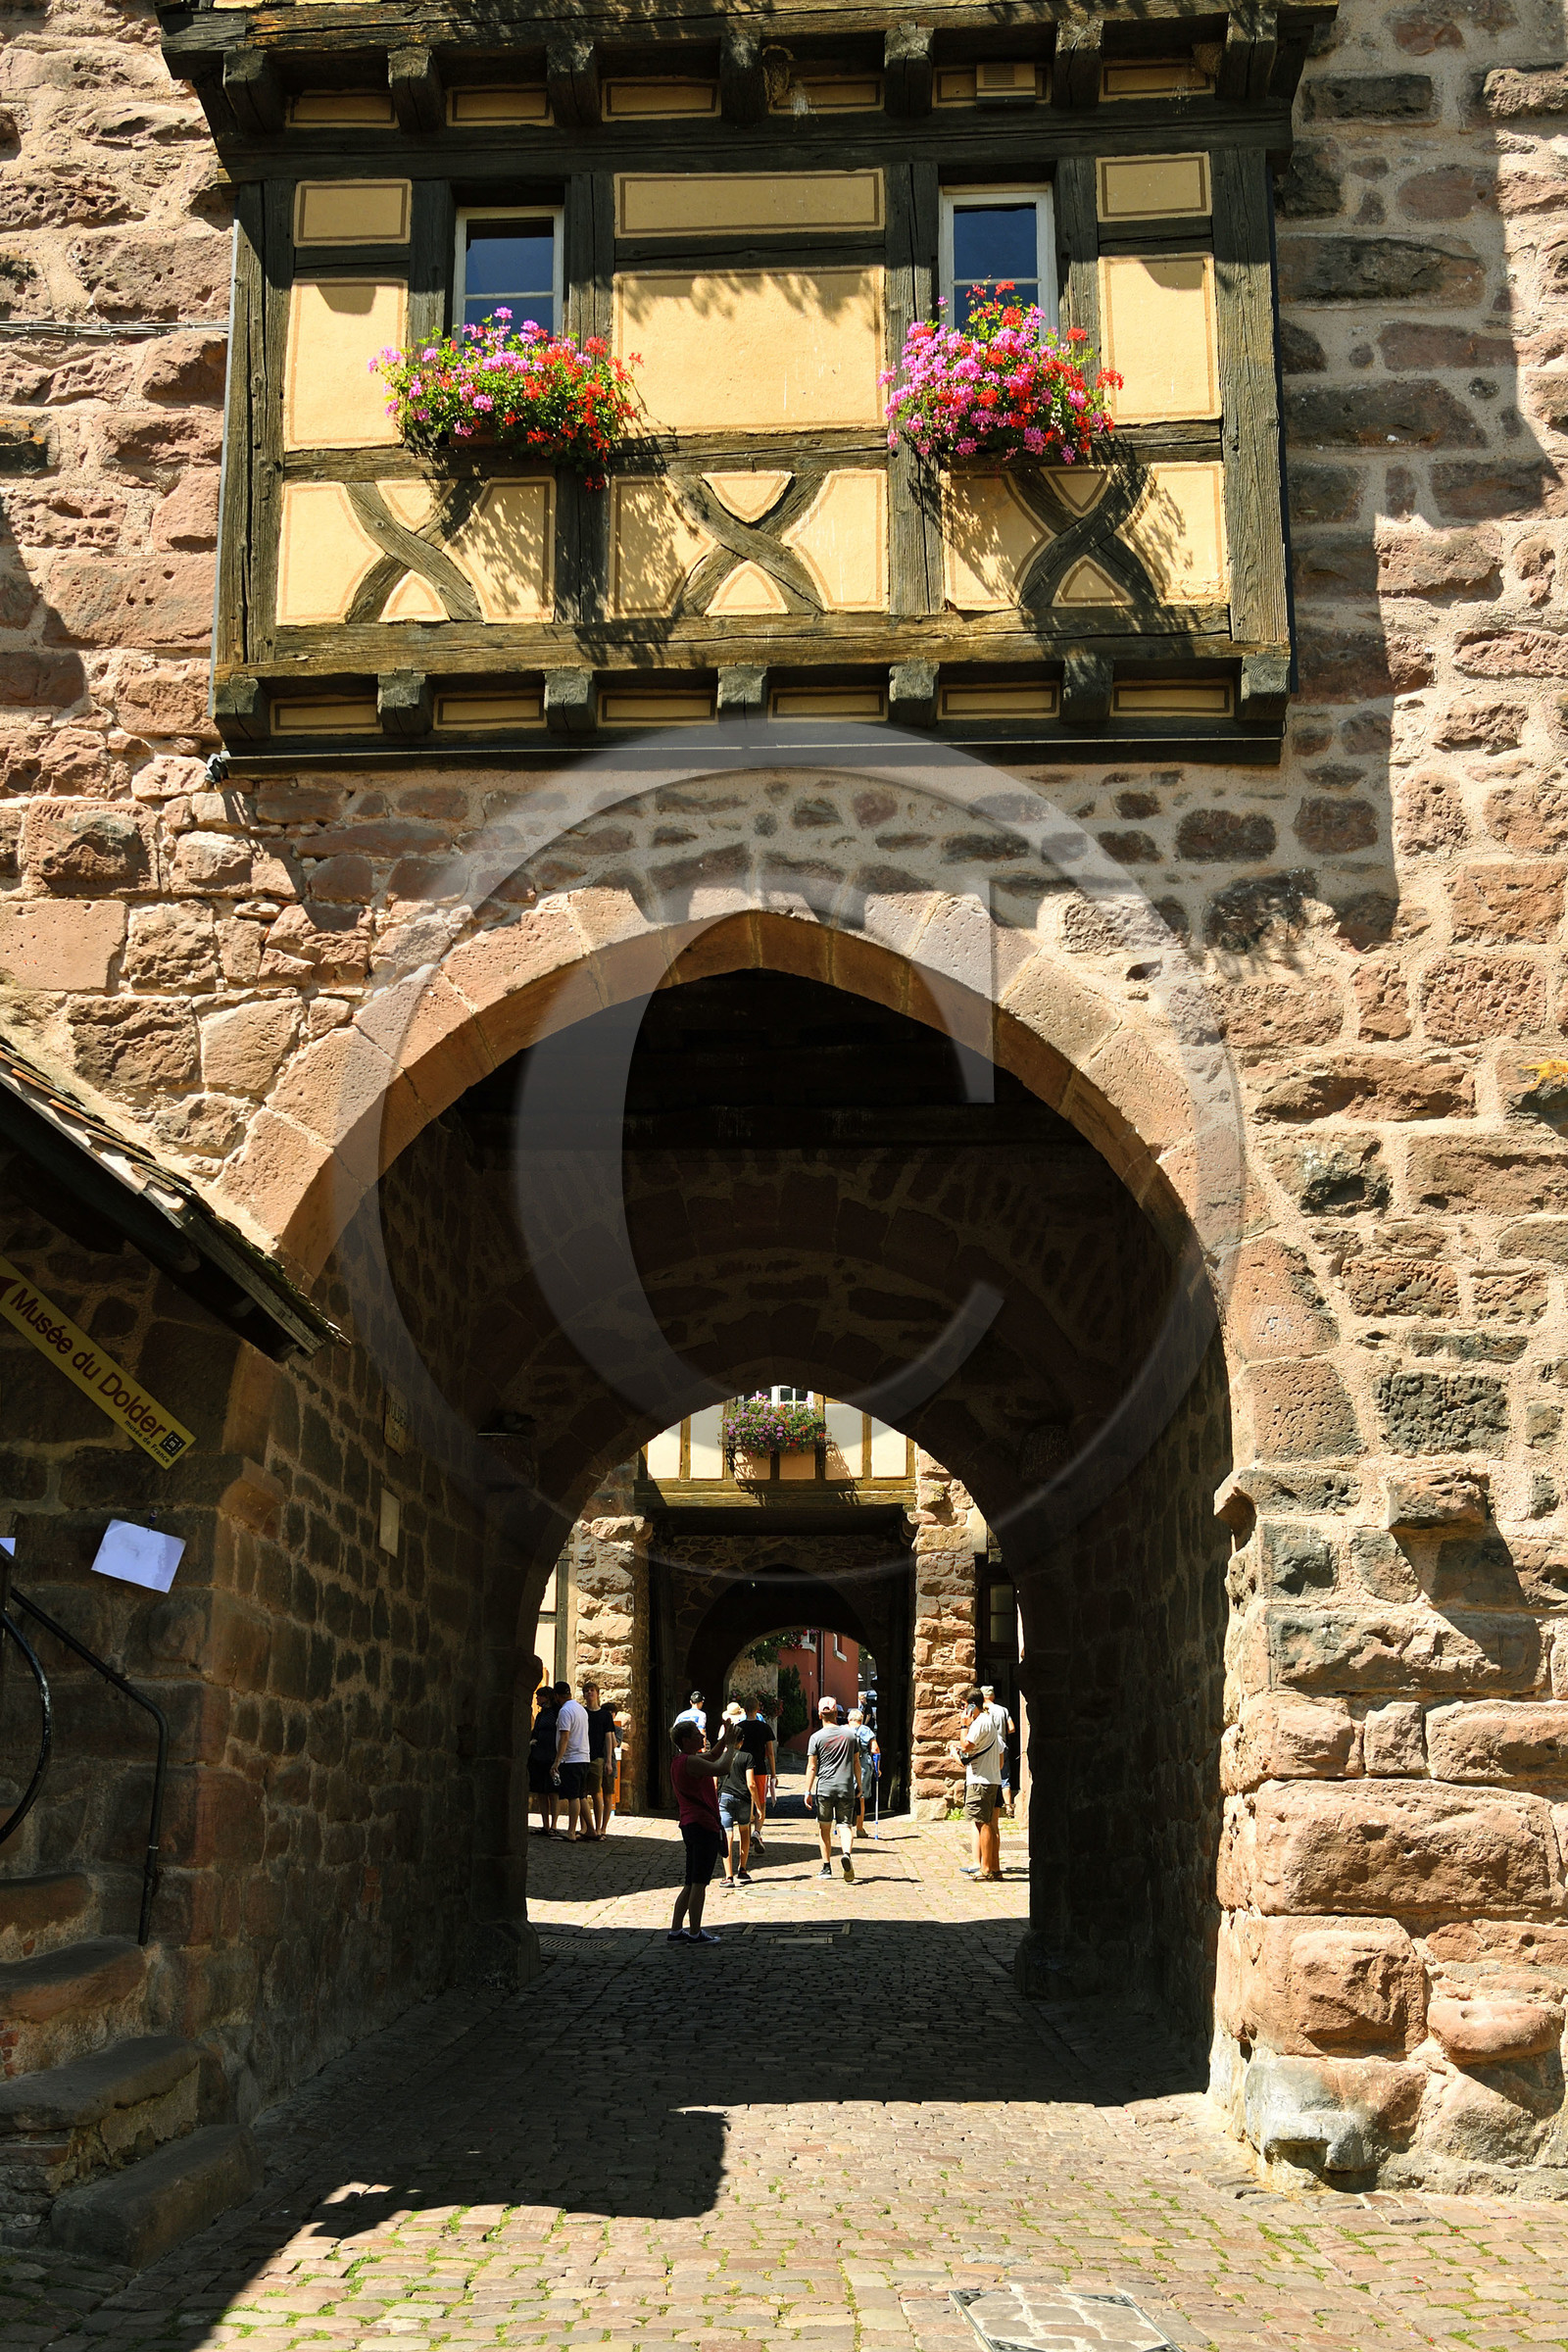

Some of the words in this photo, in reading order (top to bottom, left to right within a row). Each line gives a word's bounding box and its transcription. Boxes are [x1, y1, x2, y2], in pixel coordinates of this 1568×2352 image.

[10, 1288, 74, 1354] Musée
[73, 1350, 102, 1381] du
[98, 1373, 167, 1439] Dolder
[124, 1420, 143, 1438] musée
[142, 1437, 151, 1446] de
[150, 1444, 170, 1463] France
